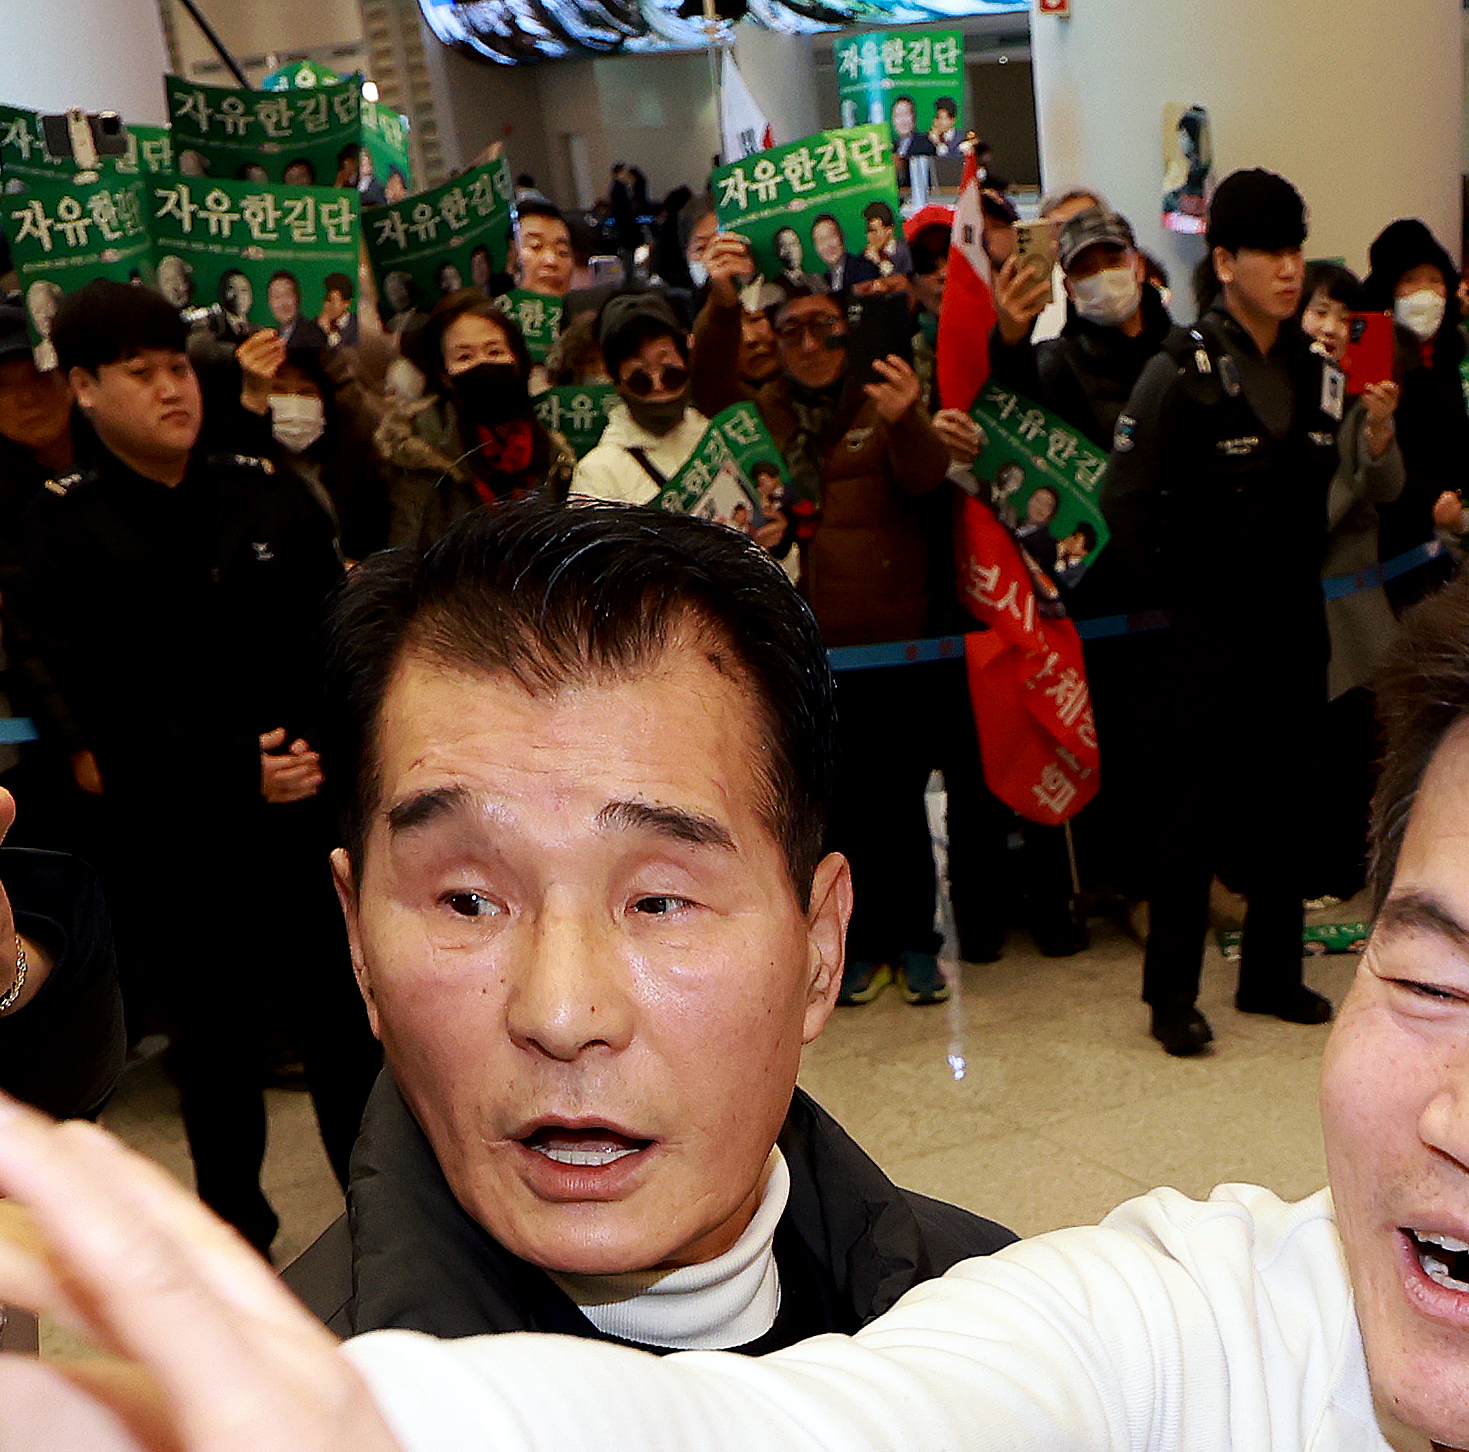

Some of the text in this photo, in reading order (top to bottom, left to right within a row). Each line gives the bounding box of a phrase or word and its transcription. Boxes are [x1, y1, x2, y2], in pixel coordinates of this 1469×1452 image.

[838, 35, 960, 79] 자유한길단
[173, 83, 358, 137] 자유한길단
[719, 131, 888, 210] 자유한길단
[154, 183, 358, 244] 자유한길단
